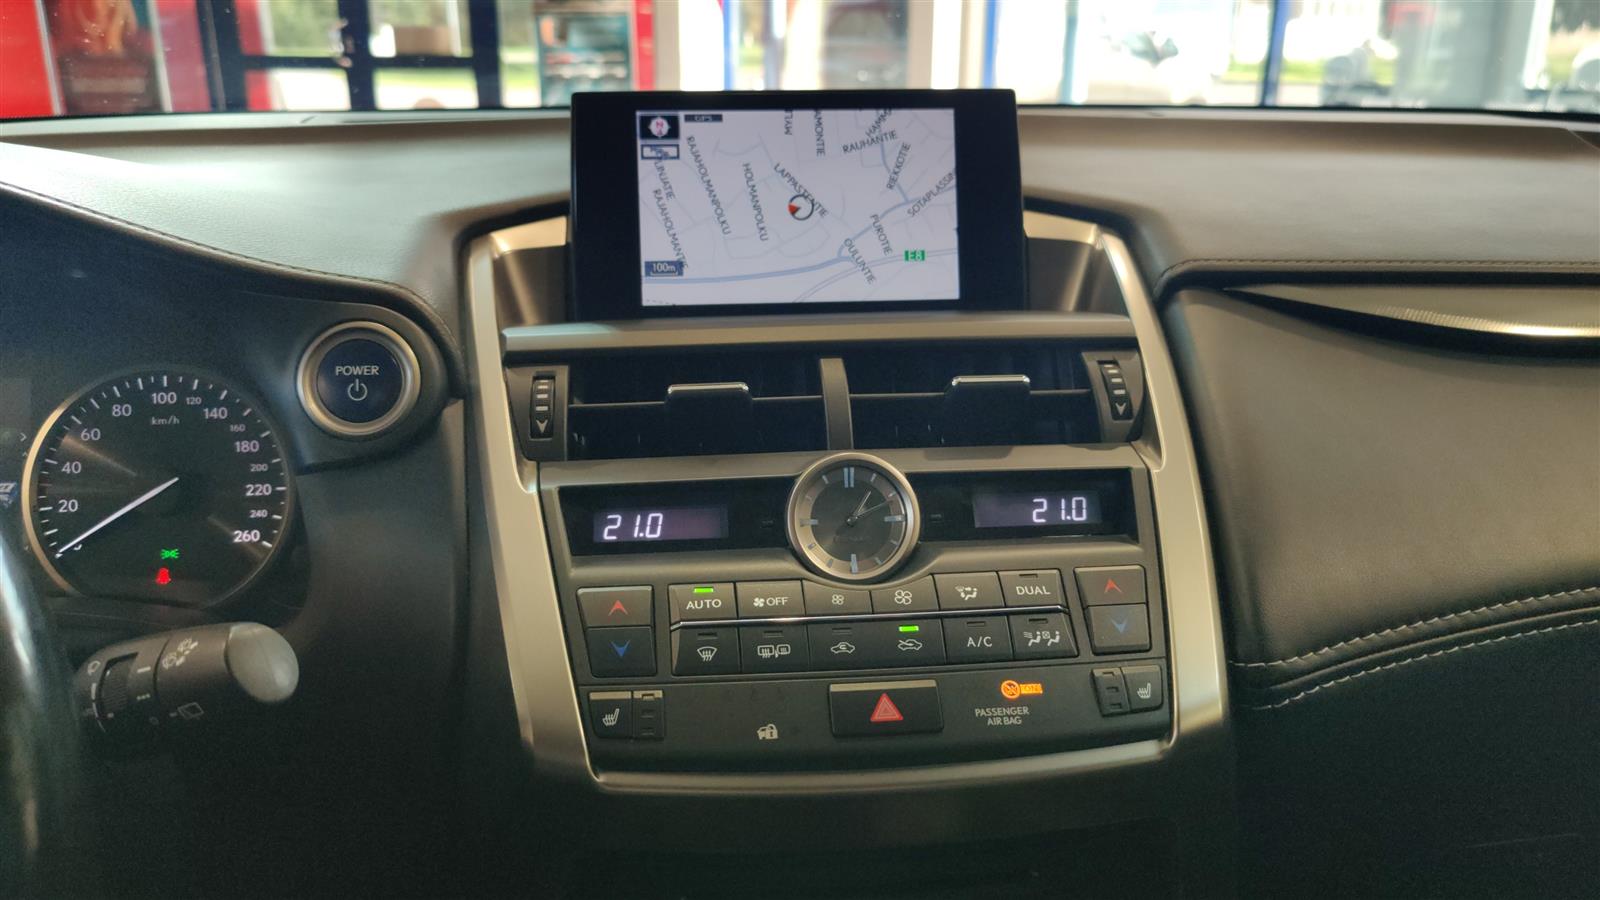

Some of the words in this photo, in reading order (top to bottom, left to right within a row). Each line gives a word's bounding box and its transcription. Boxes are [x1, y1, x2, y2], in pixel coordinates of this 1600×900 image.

[842, 130, 898, 154] RAUHANTIE
[886, 142, 911, 190] RIEKKOTIE
[686, 135, 732, 236] RAJAHOLMANPOLKU
[742, 162, 769, 242] HOLMANPOLKU
[870, 214, 893, 256] PUROTIE
[844, 238, 877, 285] OULUNTIE
[907, 250, 923, 261] E8
[652, 262, 676, 273] 100m
[335, 364, 380, 377] POWER
[151, 391, 177, 405] 100
[185, 395, 202, 405] 120
[112, 403, 132, 417] 80
[203, 406, 228, 420] 140
[151, 414, 180, 426] km/h
[80, 427, 101, 442] 60
[229, 423, 246, 433] 160
[234, 439, 260, 454] 180
[61, 460, 82, 475] 40
[250, 463, 269, 473] 200
[245, 482, 273, 497] 220
[58, 498, 79, 513] 20
[1032, 496, 1087, 523] 21.0
[249, 509, 268, 519] 240
[603, 512, 664, 541] 21.0
[233, 528, 261, 543] 260
[1015, 585, 1052, 597] DUAL
[686, 597, 722, 611] AUTO
[765, 596, 789, 607] OFF
[966, 635, 993, 649] A/C
[974, 706, 1030, 718] PASSENGER
[987, 717, 1002, 726] AIR
[1003, 716, 1022, 726] BAG
